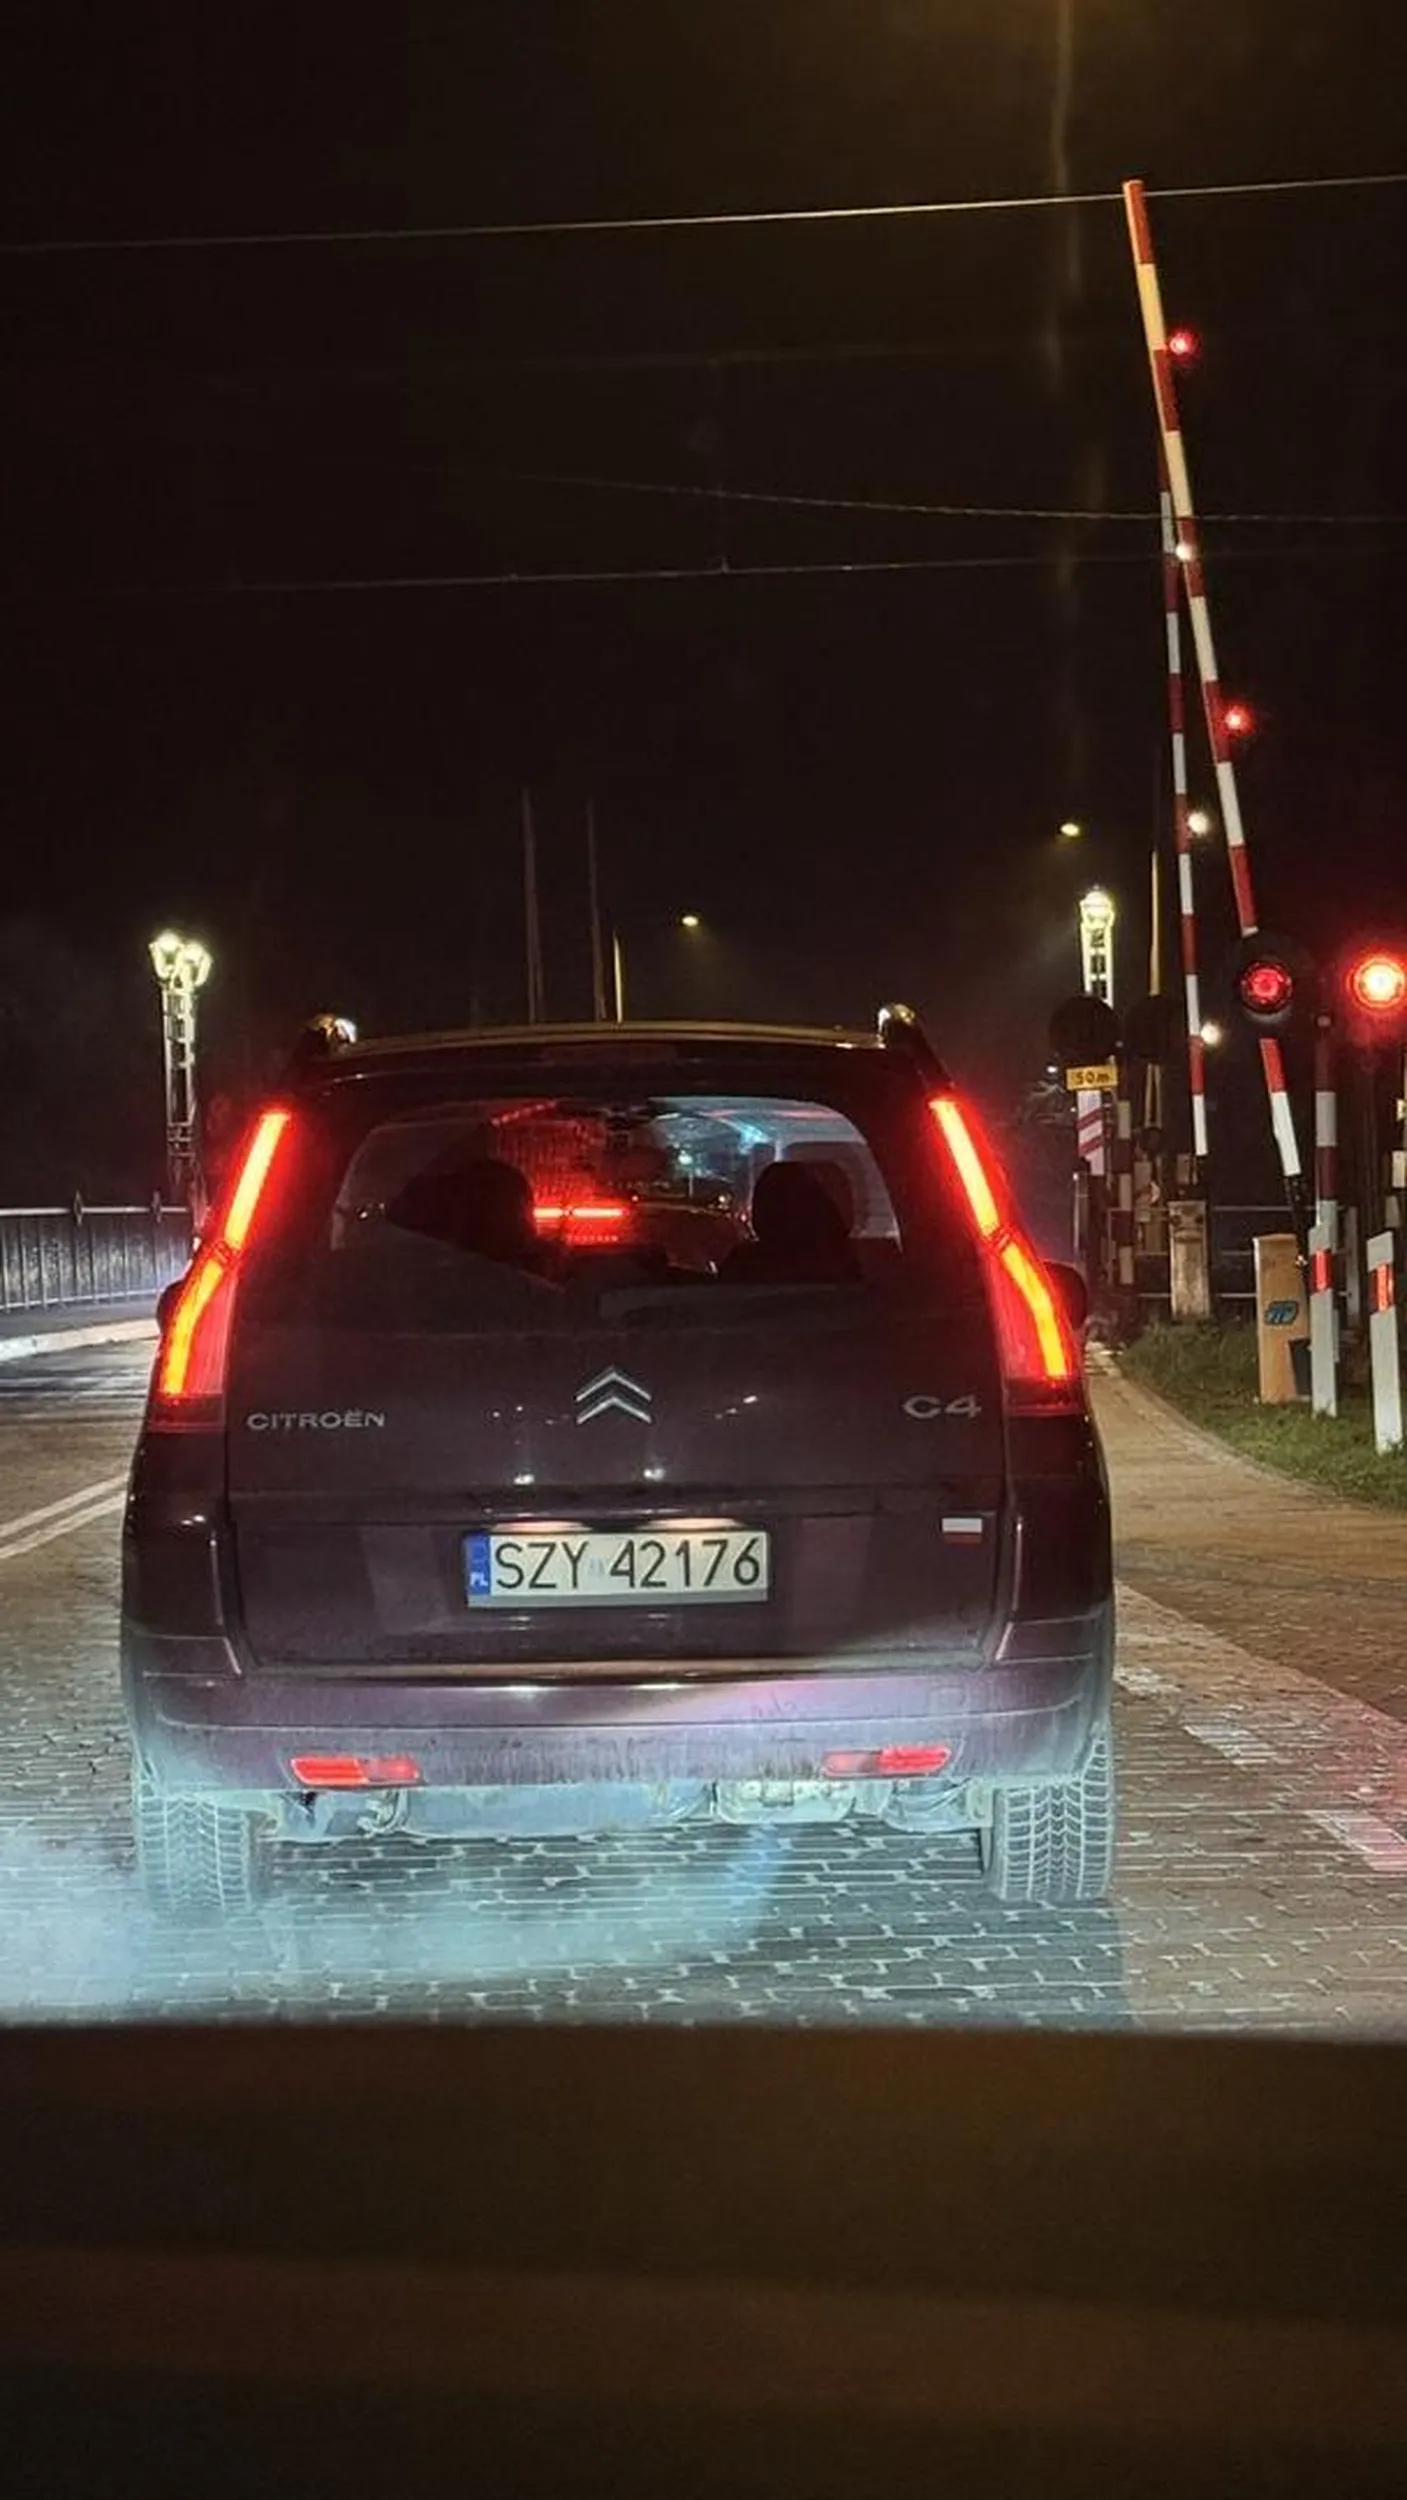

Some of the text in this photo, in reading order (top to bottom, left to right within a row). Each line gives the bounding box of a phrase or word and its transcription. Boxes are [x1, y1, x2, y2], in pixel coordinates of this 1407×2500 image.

[902, 1395, 982, 1419] C4
[246, 1410, 386, 1430] CITROËN
[494, 1537, 761, 1590] SZY 42176
[469, 1571, 489, 1587] PL
